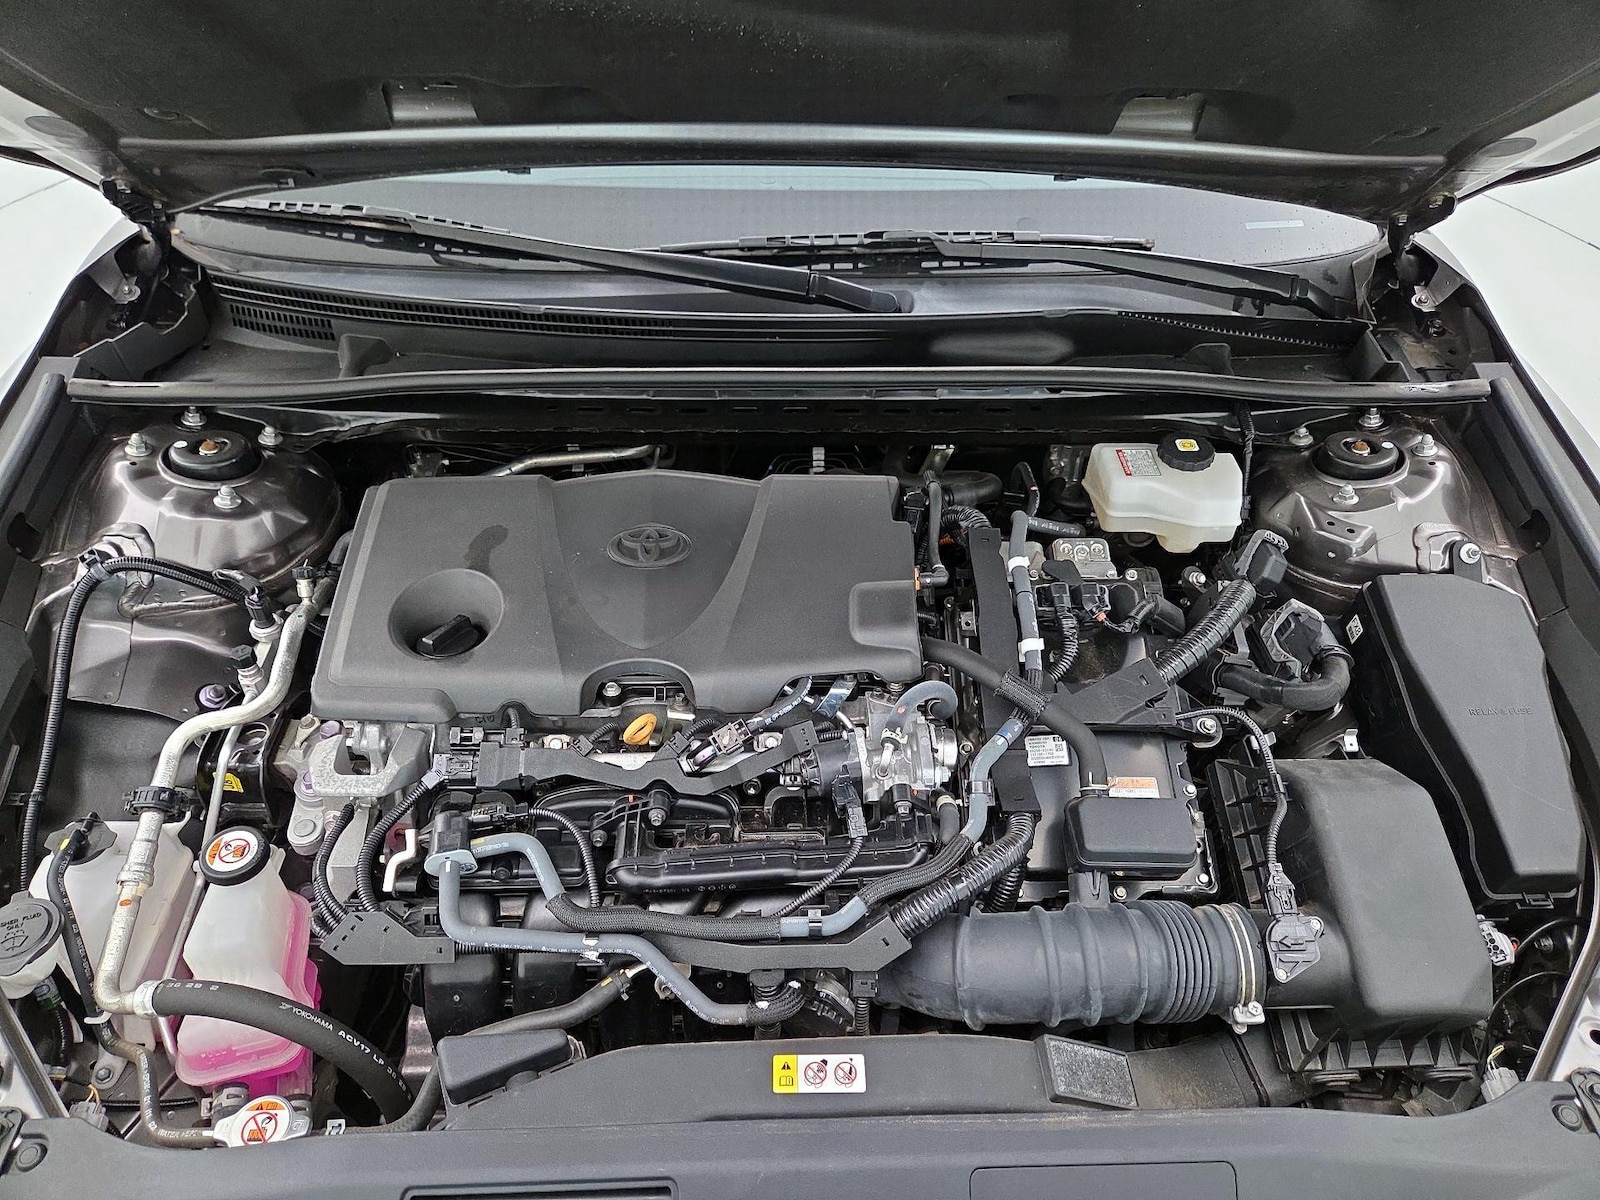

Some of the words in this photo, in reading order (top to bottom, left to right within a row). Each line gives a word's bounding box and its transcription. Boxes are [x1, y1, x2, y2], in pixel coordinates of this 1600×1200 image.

[1467, 707, 1499, 716] RELAY
[1508, 706, 1534, 715] FUSE
[0, 919, 19, 927] SHER
[22, 912, 42, 921] FLUID
[6, 922, 24, 931] ONLY
[291, 1006, 334, 1031] YOKOHAMA
[337, 1029, 371, 1054] ACV17
[372, 1053, 385, 1066] LP
